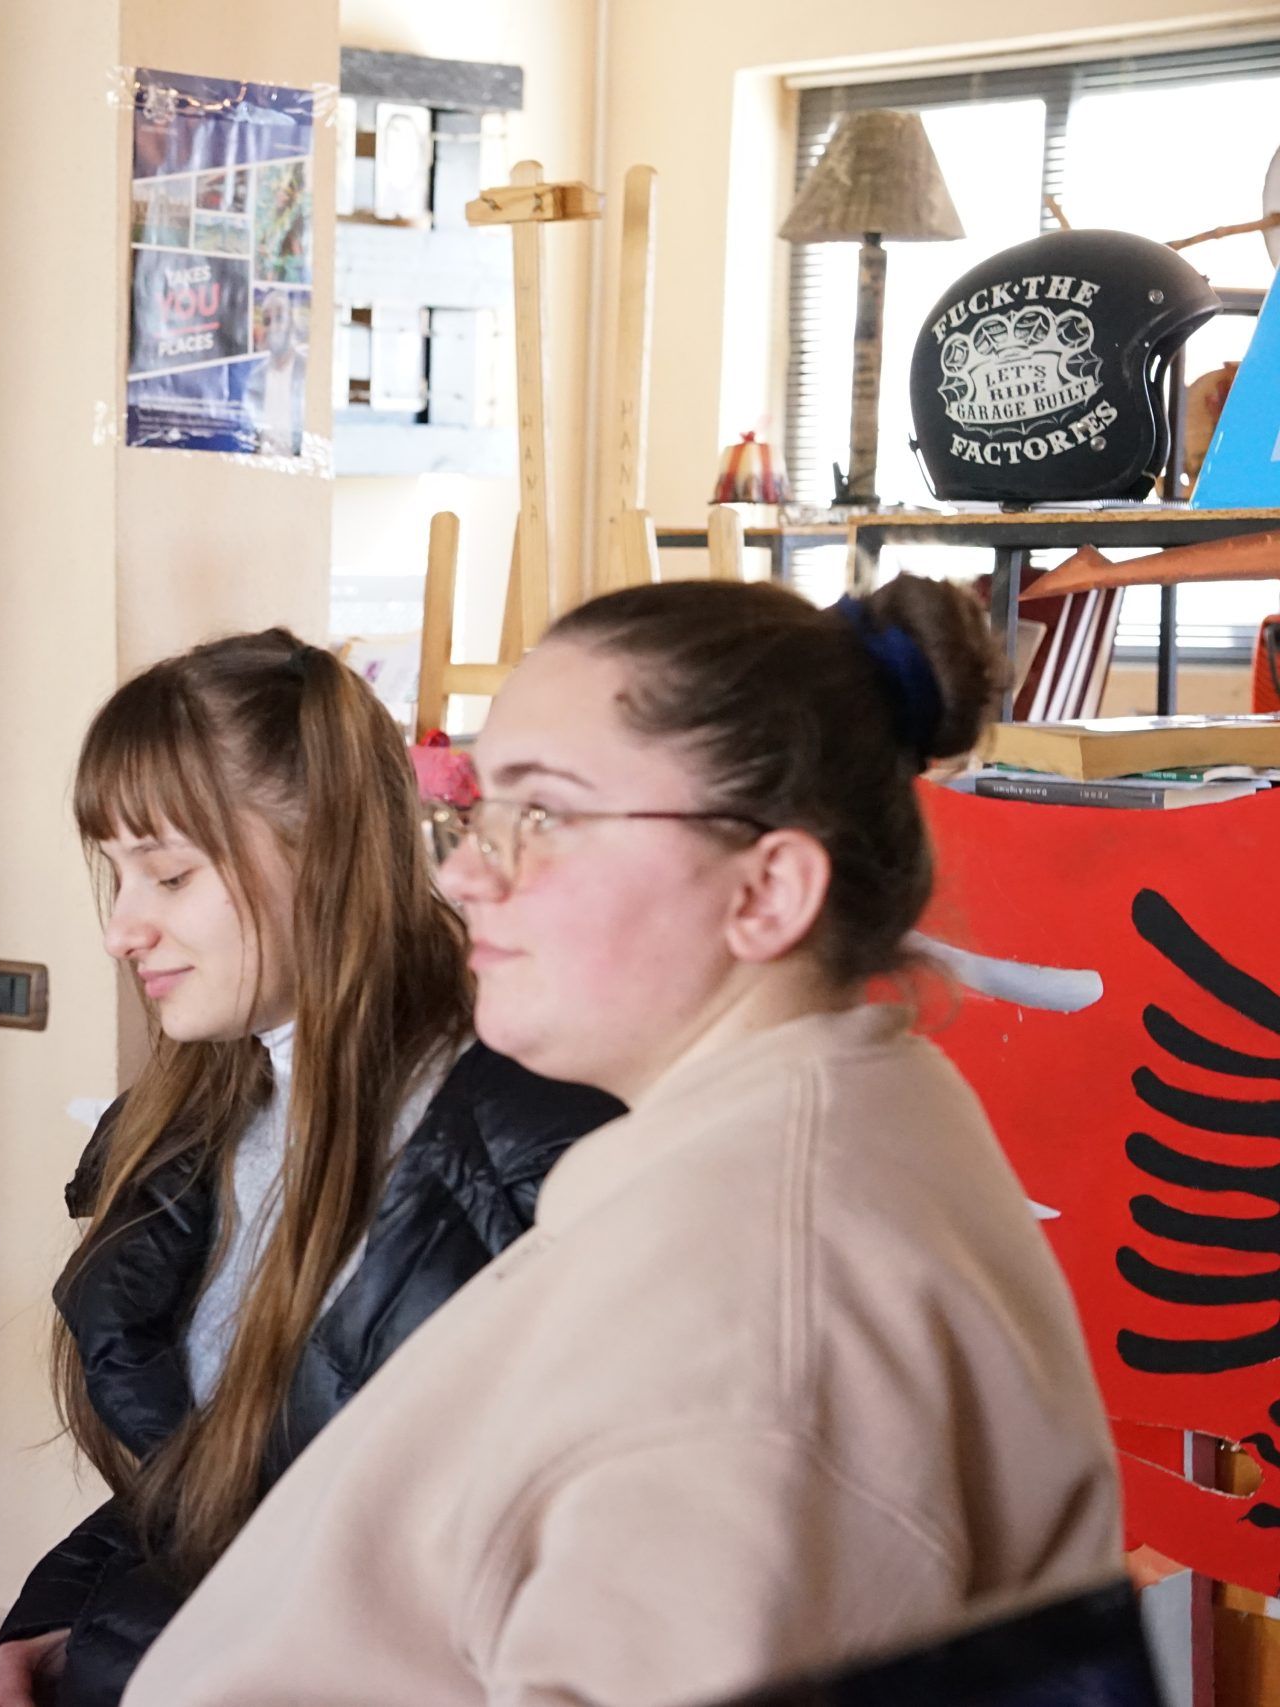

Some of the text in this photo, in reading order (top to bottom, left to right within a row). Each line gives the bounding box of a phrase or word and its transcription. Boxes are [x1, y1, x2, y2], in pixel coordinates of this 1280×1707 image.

[165, 265, 211, 288] TAKES
[155, 282, 221, 322] YOU
[158, 332, 214, 357] PLACES
[984, 364, 1048, 388] LET'S
[956, 383, 1089, 422] GARAGE BUILT
[989, 380, 1047, 402] RIDE
[949, 400, 1118, 466] FACTORIES
